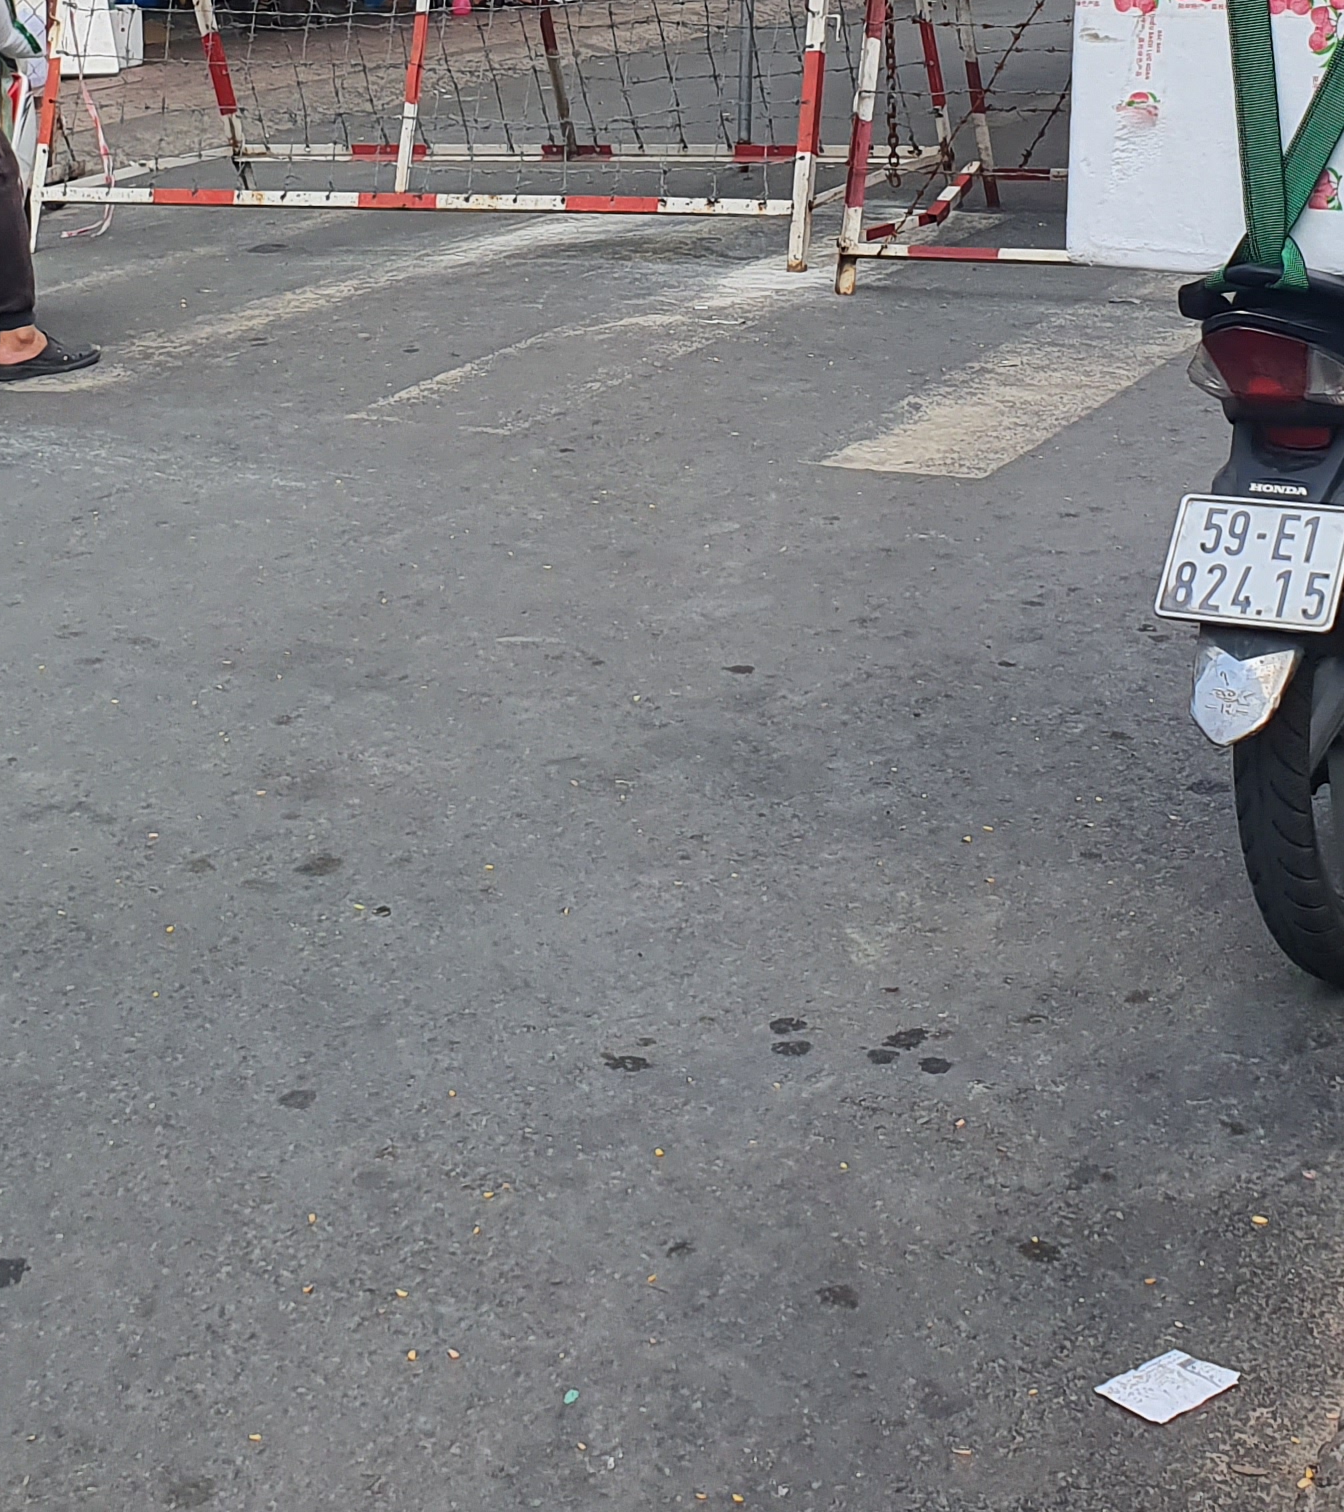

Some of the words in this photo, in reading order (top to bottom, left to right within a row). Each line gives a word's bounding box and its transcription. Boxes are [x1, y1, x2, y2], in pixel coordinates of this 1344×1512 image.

[1249, 483, 1308, 496] HONDA
[1200, 508, 1321, 563] 59-E1
[1174, 561, 1330, 620] 824.15
